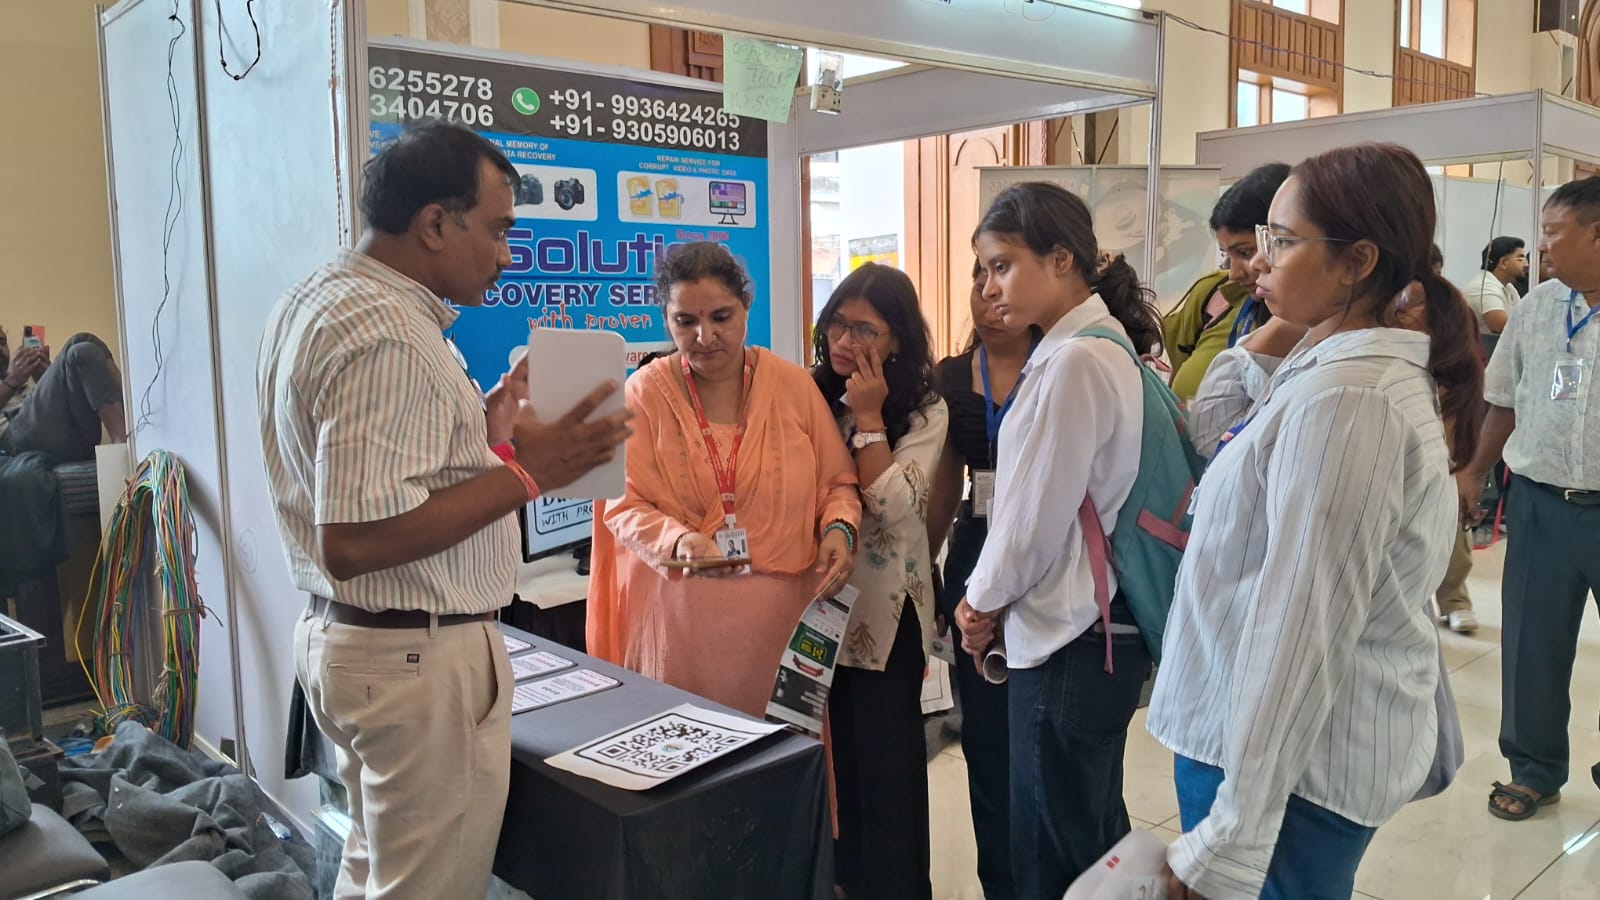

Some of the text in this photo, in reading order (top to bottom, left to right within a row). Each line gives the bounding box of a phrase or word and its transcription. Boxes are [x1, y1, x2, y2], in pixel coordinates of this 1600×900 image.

[369, 66, 493, 100] 6255278
[370, 94, 494, 126] 3404706
[549, 88, 604, 111] +91-
[611, 94, 740, 128] 9936424265
[506, 140, 538, 150] MEMORY
[540, 143, 549, 151] OF
[550, 114, 740, 150] +91- 9305906013
[517, 151, 556, 161] RECOVERY
[448, 281, 601, 308] COVERY
[527, 301, 652, 331] with proven
[541, 510, 569, 527] WITH
